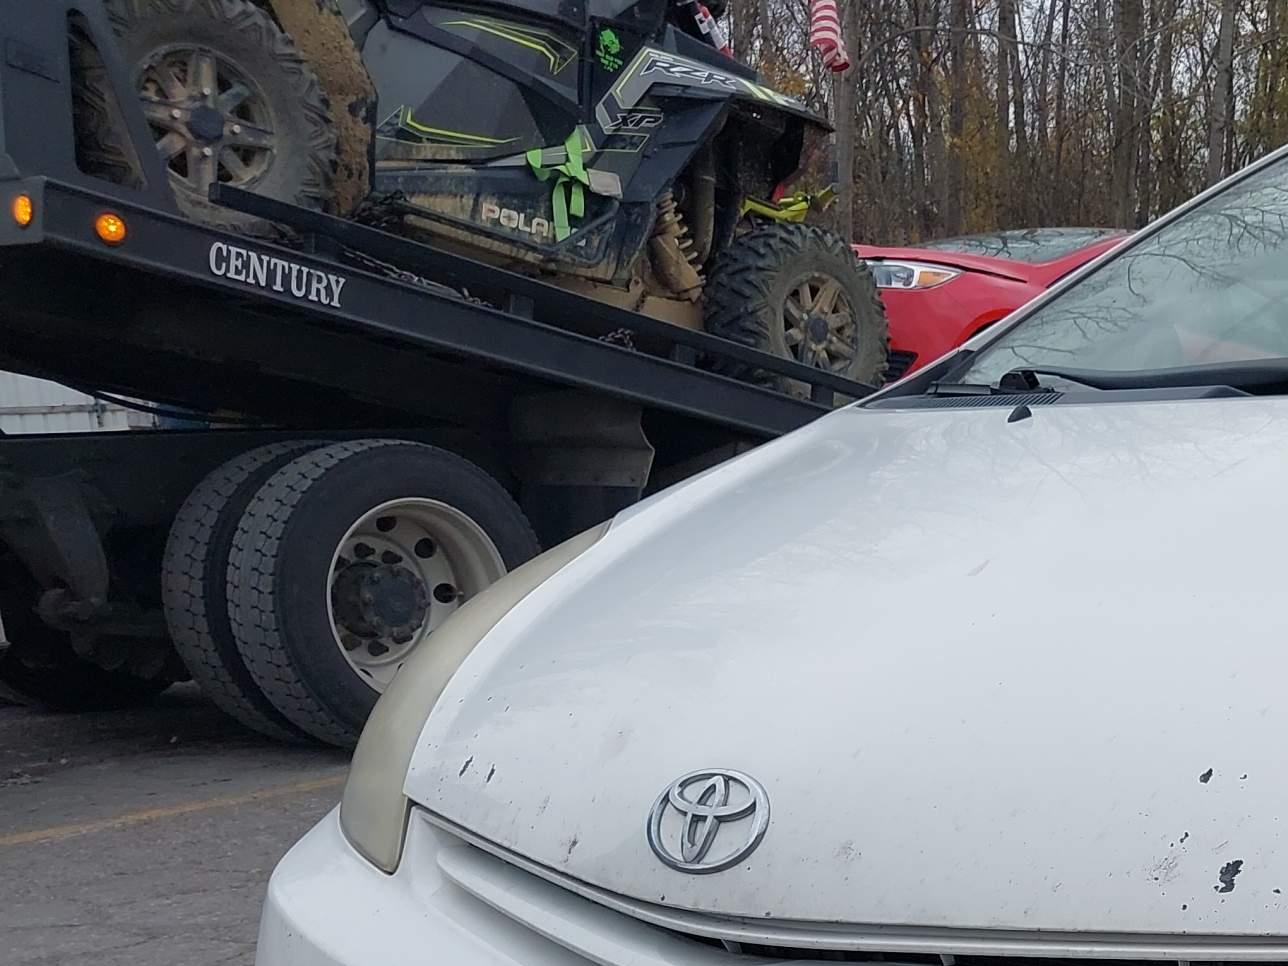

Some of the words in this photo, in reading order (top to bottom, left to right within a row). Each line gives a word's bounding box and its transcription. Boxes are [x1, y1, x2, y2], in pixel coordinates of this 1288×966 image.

[640, 58, 737, 90] RZR
[605, 113, 664, 129] XP
[209, 242, 346, 307] CENTURY
